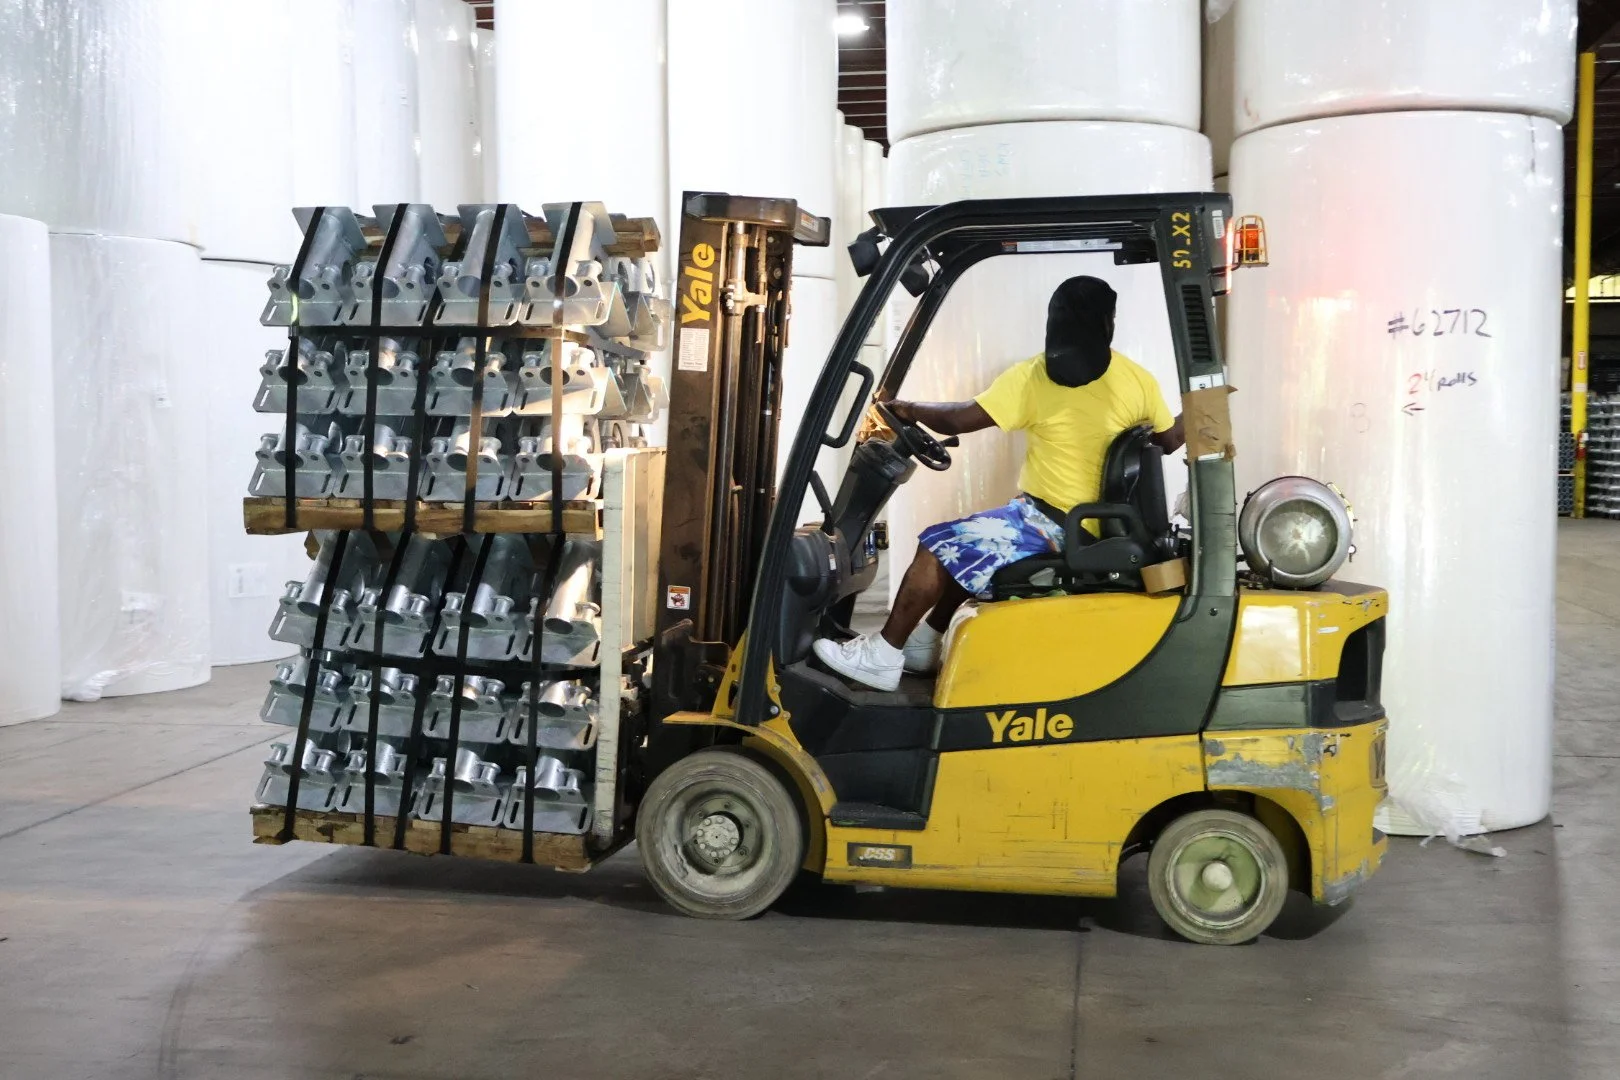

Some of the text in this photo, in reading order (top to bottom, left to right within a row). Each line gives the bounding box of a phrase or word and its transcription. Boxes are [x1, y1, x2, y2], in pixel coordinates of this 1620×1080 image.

[681, 243, 716, 324] Yale
[1387, 308, 1492, 340] #62712
[985, 707, 1074, 743] Yale
